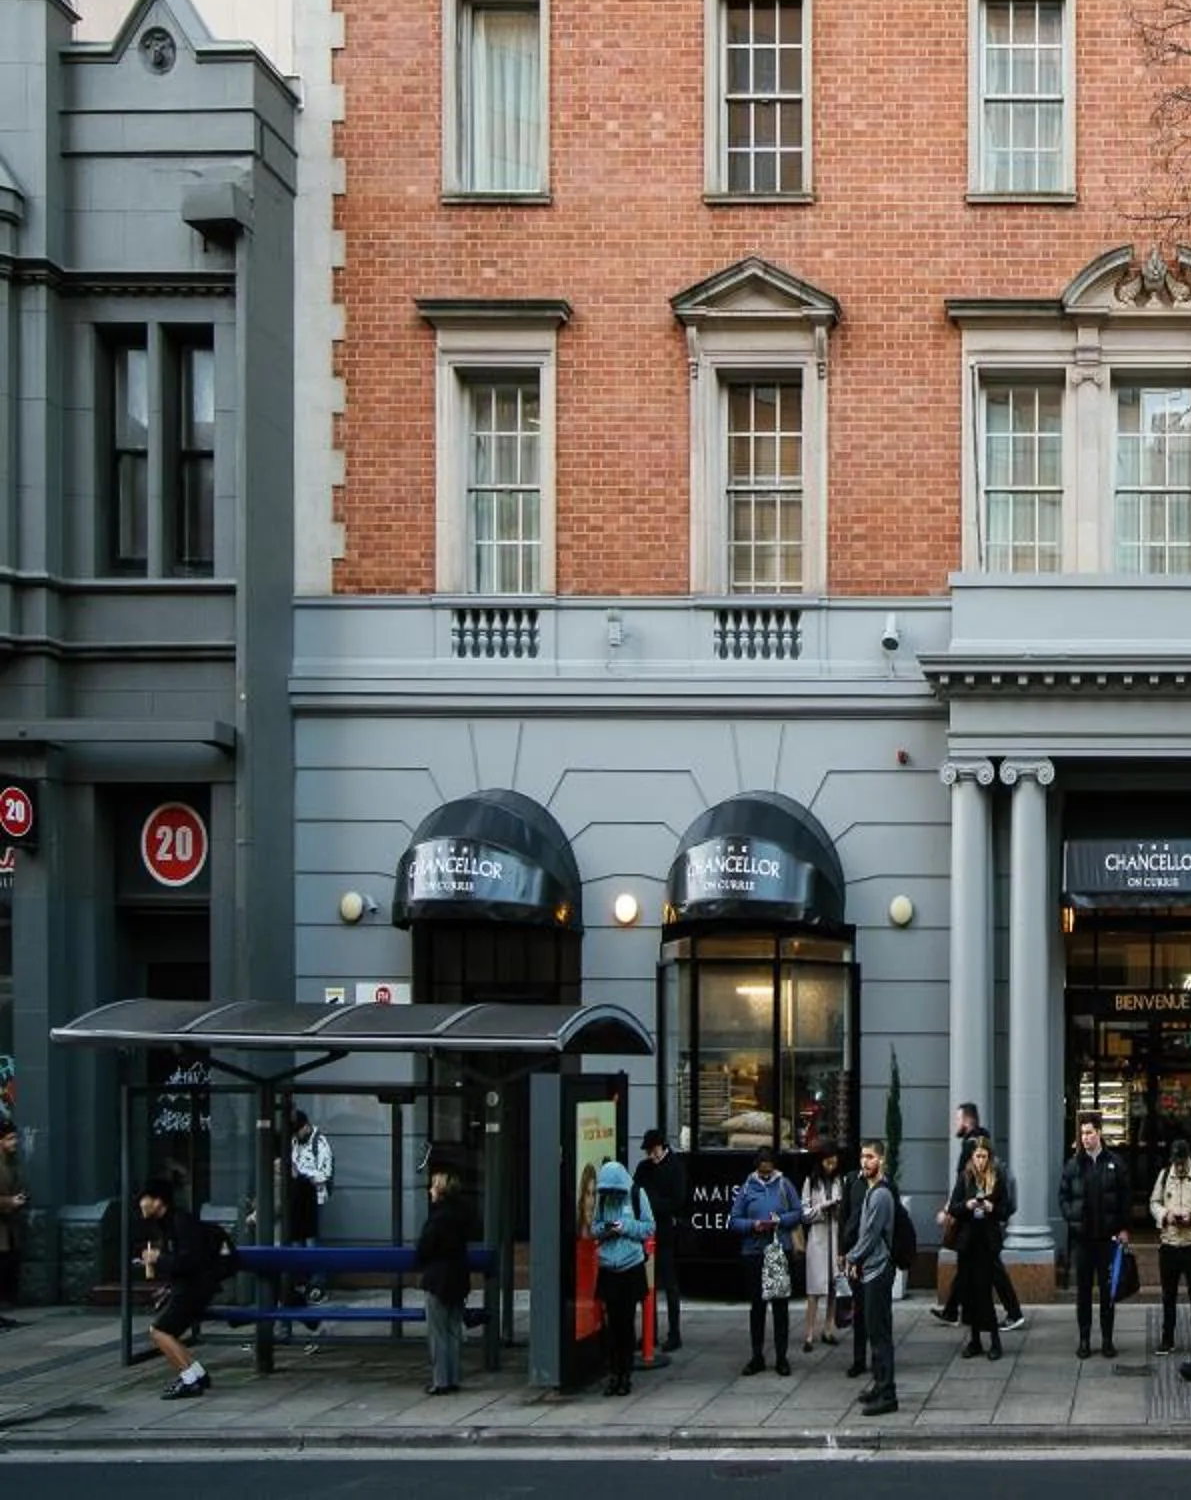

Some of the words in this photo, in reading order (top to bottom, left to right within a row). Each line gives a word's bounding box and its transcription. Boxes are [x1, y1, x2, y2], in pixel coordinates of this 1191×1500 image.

[5, 799, 25, 822] 20
[156, 825, 193, 861] 20
[408, 856, 503, 880] CHANCELLOR
[686, 855, 780, 879] CHANCELLOR
[1127, 877, 1142, 888] ON
[1115, 993, 1190, 1011] BIENVENUE
